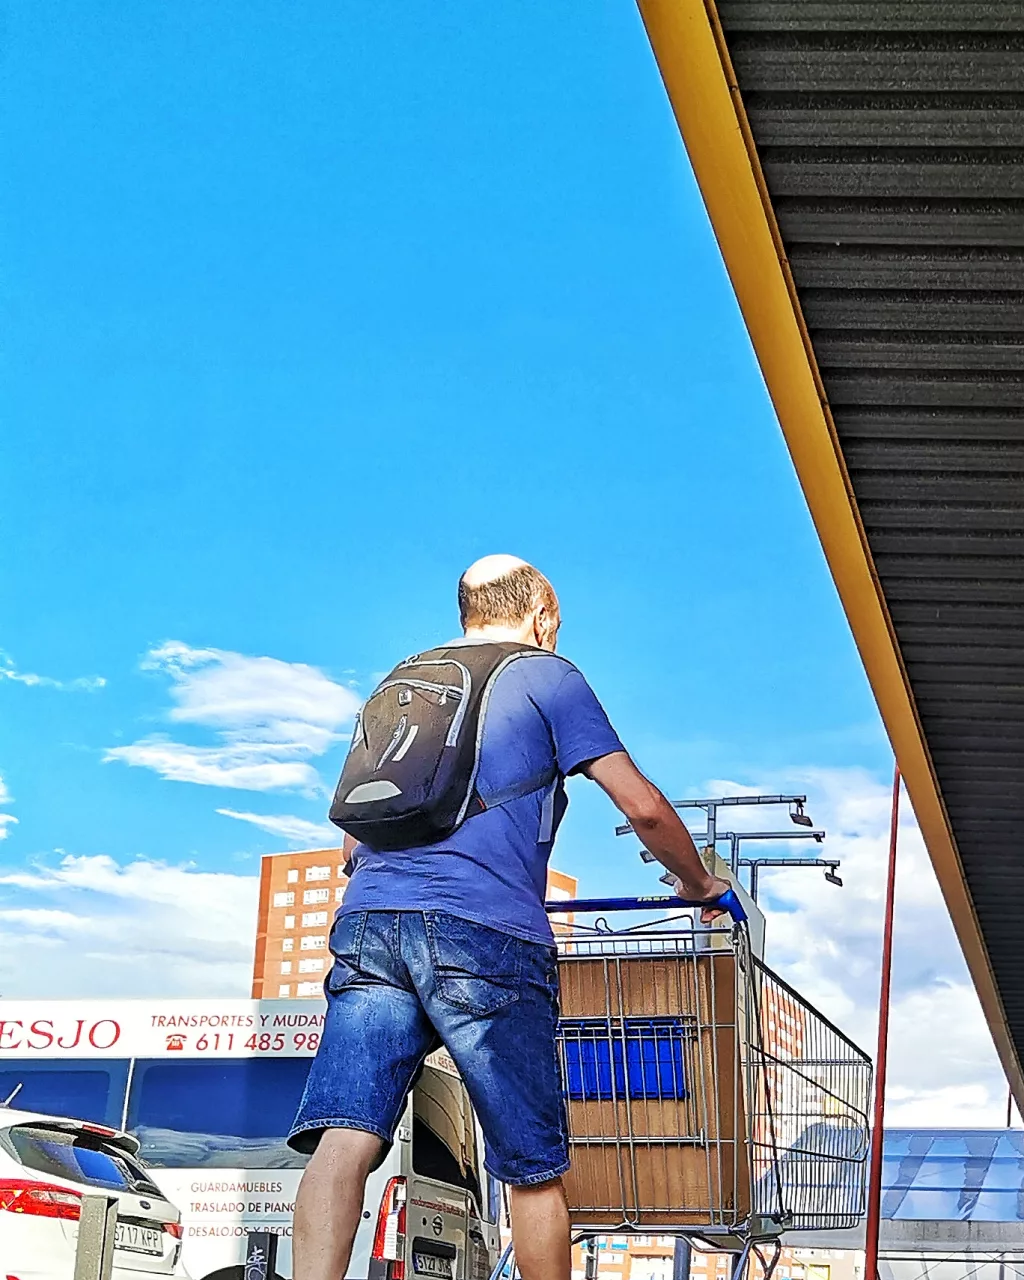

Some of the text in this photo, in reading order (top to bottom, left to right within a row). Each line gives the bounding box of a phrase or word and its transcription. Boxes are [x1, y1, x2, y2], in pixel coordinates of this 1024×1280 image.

[151, 1014, 253, 1027] TRANSPORTES
[260, 1014, 270, 1027] Y
[0, 1019, 121, 1049] ESJO
[195, 1033, 234, 1051] 611
[244, 1033, 285, 1051] 485
[190, 1182, 282, 1193] GUARDAMUEBLES
[190, 1202, 245, 1213] TRASLADO
[248, 1202, 262, 1213] DE
[188, 1225, 248, 1237] DESALOJOS
